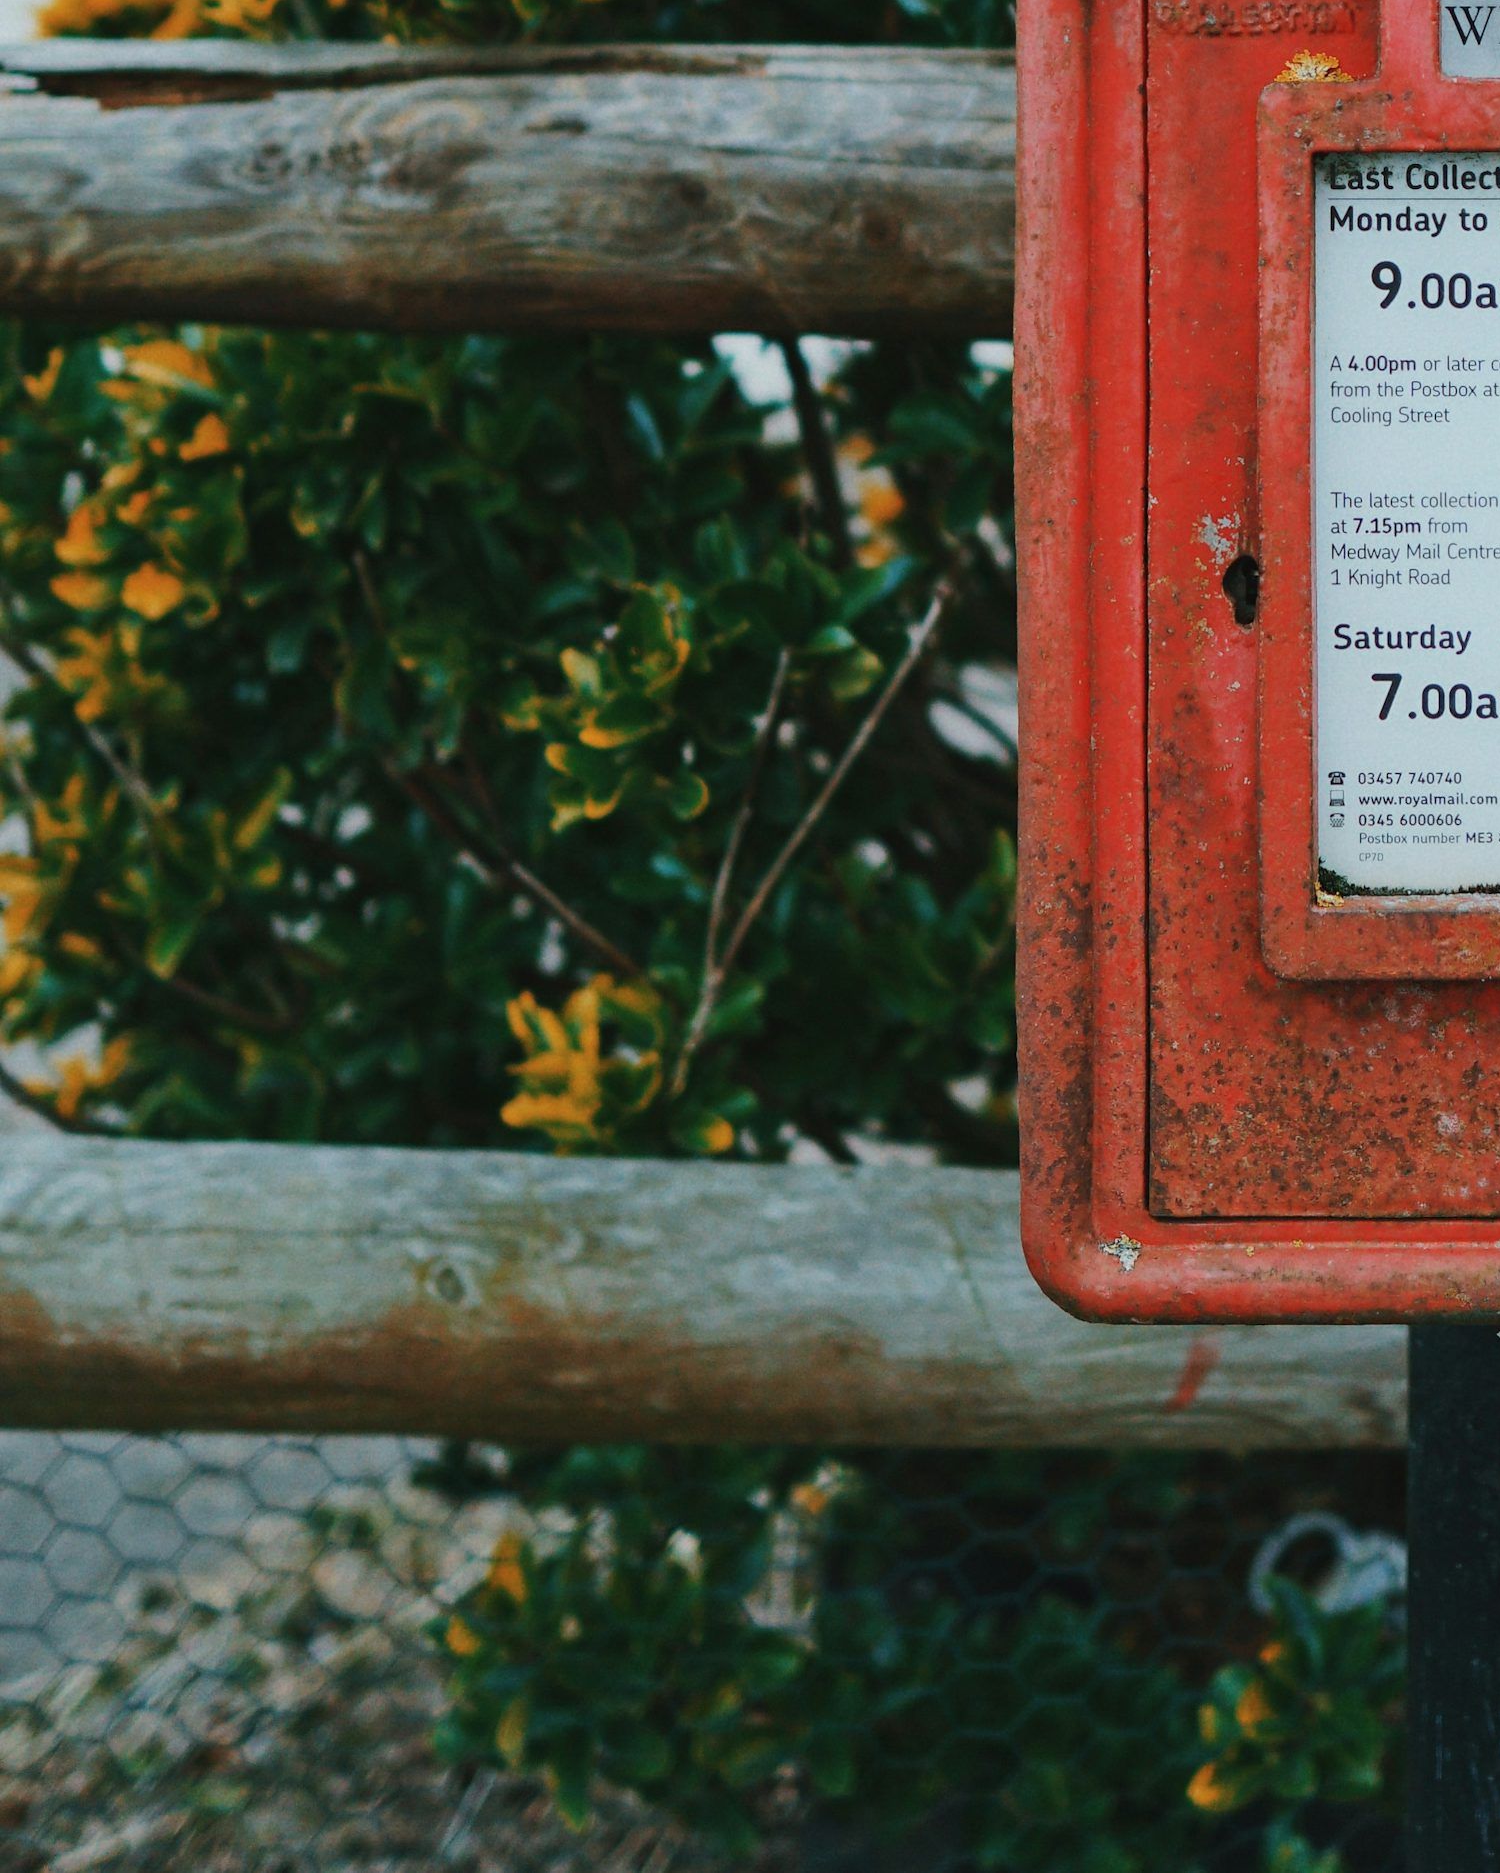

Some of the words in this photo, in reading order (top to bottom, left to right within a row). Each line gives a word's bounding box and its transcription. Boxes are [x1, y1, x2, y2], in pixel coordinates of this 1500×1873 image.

[1329, 164, 1394, 190] Last
[1330, 205, 1447, 237] Monday
[1459, 208, 1488, 232] to
[1330, 357, 1342, 372] A
[1347, 355, 1416, 376] 4.00pm
[1423, 359, 1441, 372] or
[1447, 355, 1486, 372] later
[1330, 381, 1371, 398] from
[1377, 381, 1404, 398] the
[1411, 381, 1478, 398] Postbox
[1483, 383, 1500, 398] at
[1330, 406, 1392, 427] Cooling
[1399, 406, 1450, 424] Street
[1331, 492, 1363, 509] The
[1369, 492, 1415, 509] latest
[1421, 491, 1499, 509] collection
[1330, 519, 1348, 535] at
[1353, 517, 1421, 538] 7.15pm
[1428, 517, 1468, 534] from
[1331, 542, 1400, 563] Medway
[1407, 542, 1441, 560] Mail
[1331, 569, 1342, 586] 1
[1349, 568, 1402, 589] Knight
[1408, 568, 1451, 586] Road
[1334, 624, 1472, 655] Saturday
[1358, 772, 1402, 786] 03457
[1408, 772, 1462, 786] 740740
[1359, 791, 1498, 808] www.royalmail.com
[1358, 813, 1393, 827] 0345
[1400, 813, 1463, 827] 6000606
[1359, 832, 1408, 845] Postbox
[1413, 832, 1461, 845] number
[1466, 832, 1493, 845] ME3
